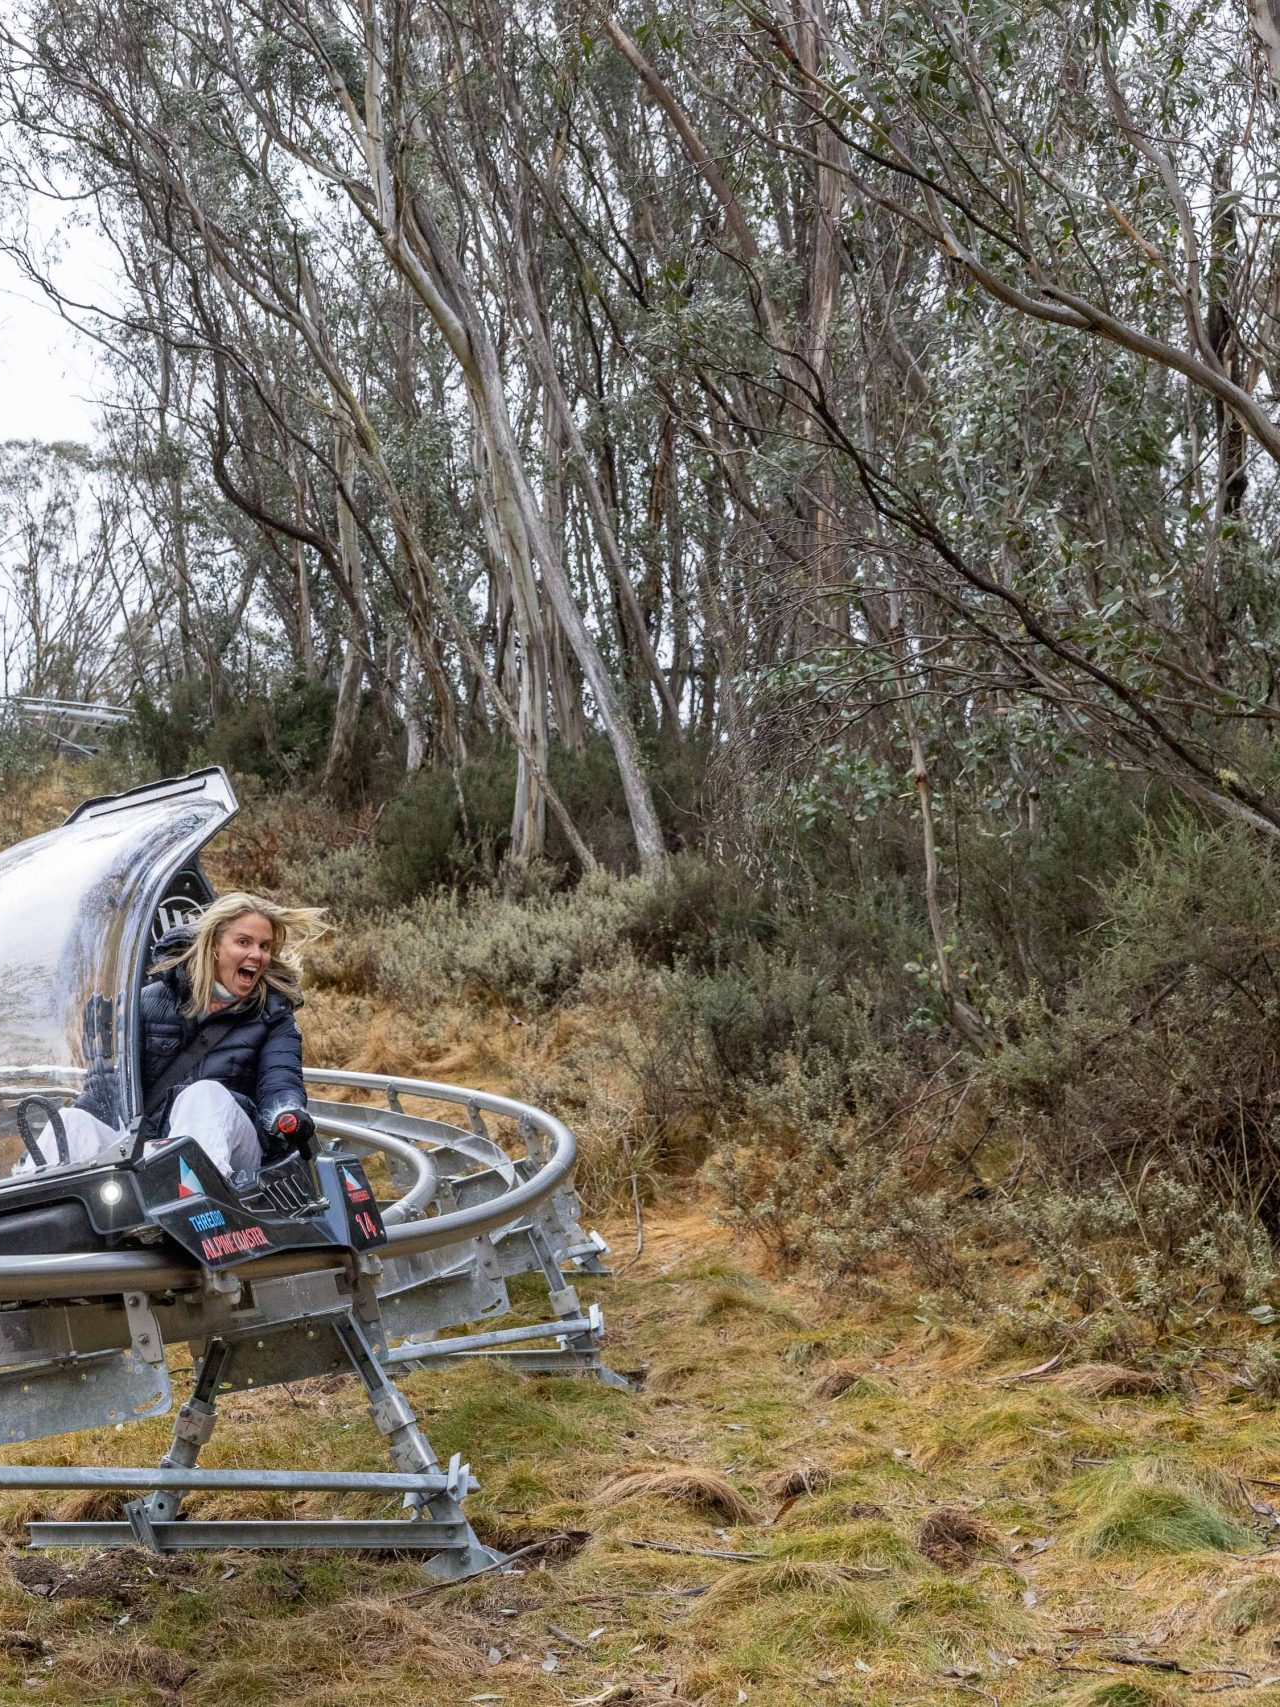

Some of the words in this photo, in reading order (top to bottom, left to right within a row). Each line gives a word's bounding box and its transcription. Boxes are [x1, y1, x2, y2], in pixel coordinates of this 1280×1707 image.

[355, 1211, 377, 1239] 14
[201, 1234, 237, 1260] ALPINE
[232, 1227, 269, 1250] COASTER
